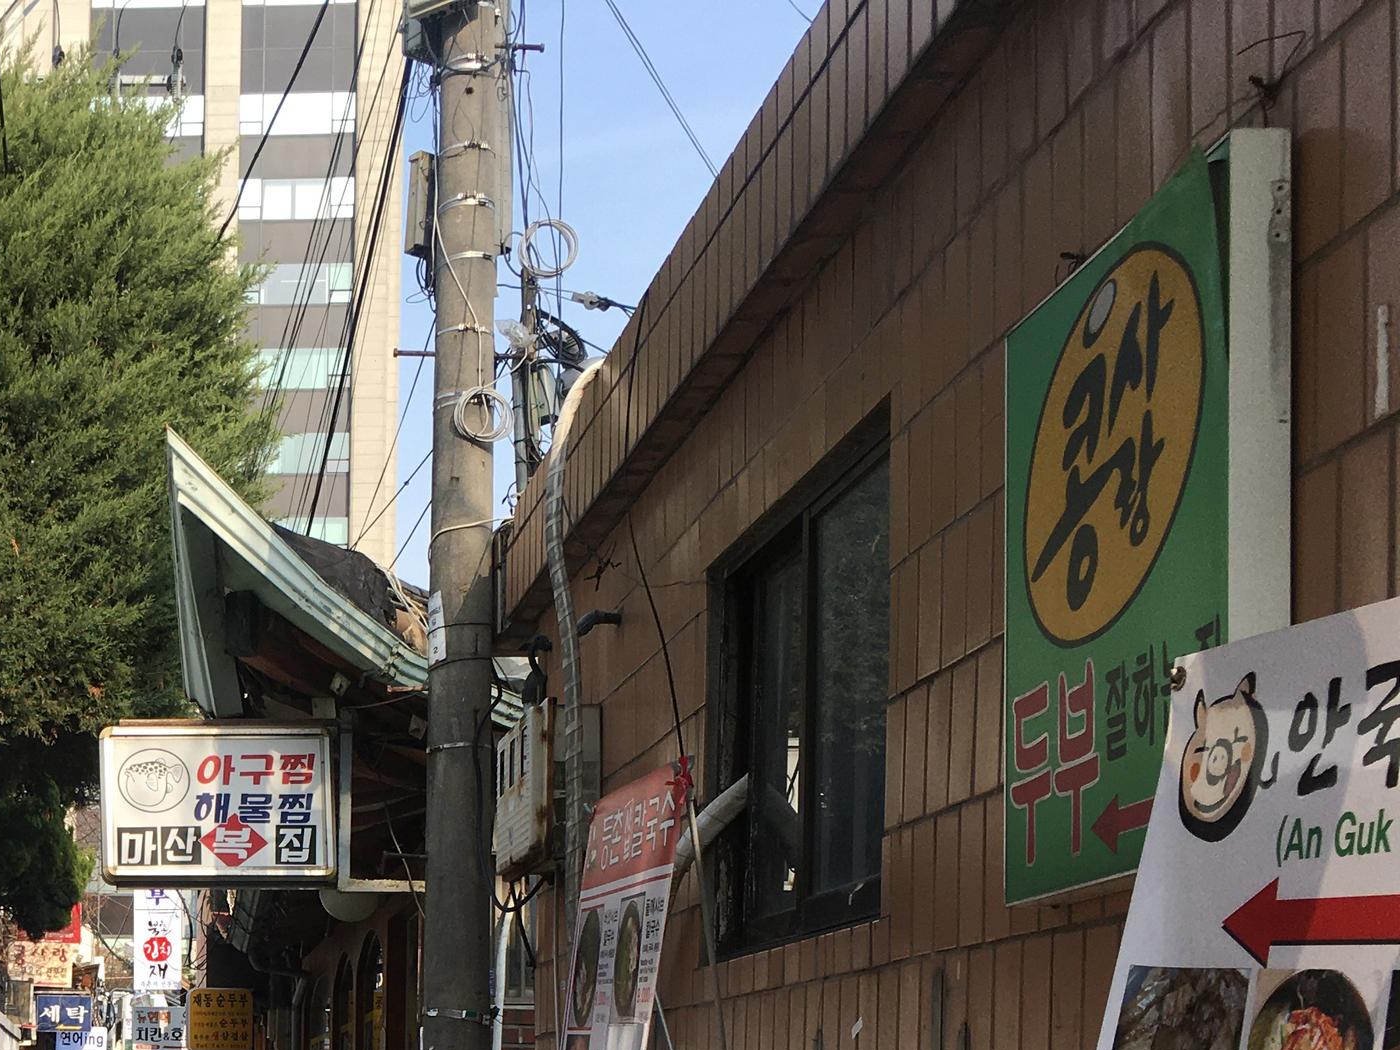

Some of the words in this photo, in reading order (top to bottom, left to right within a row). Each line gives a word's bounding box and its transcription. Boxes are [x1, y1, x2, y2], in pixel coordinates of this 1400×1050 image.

[196, 754, 316, 785] 아구찜
[1011, 655, 1099, 867] 두부
[193, 792, 313, 824] 해물찜
[1333, 808, 1394, 858] Guk
[39, 1003, 89, 1025] 세탁
[60, 1031, 104, 1047] 연어ing
